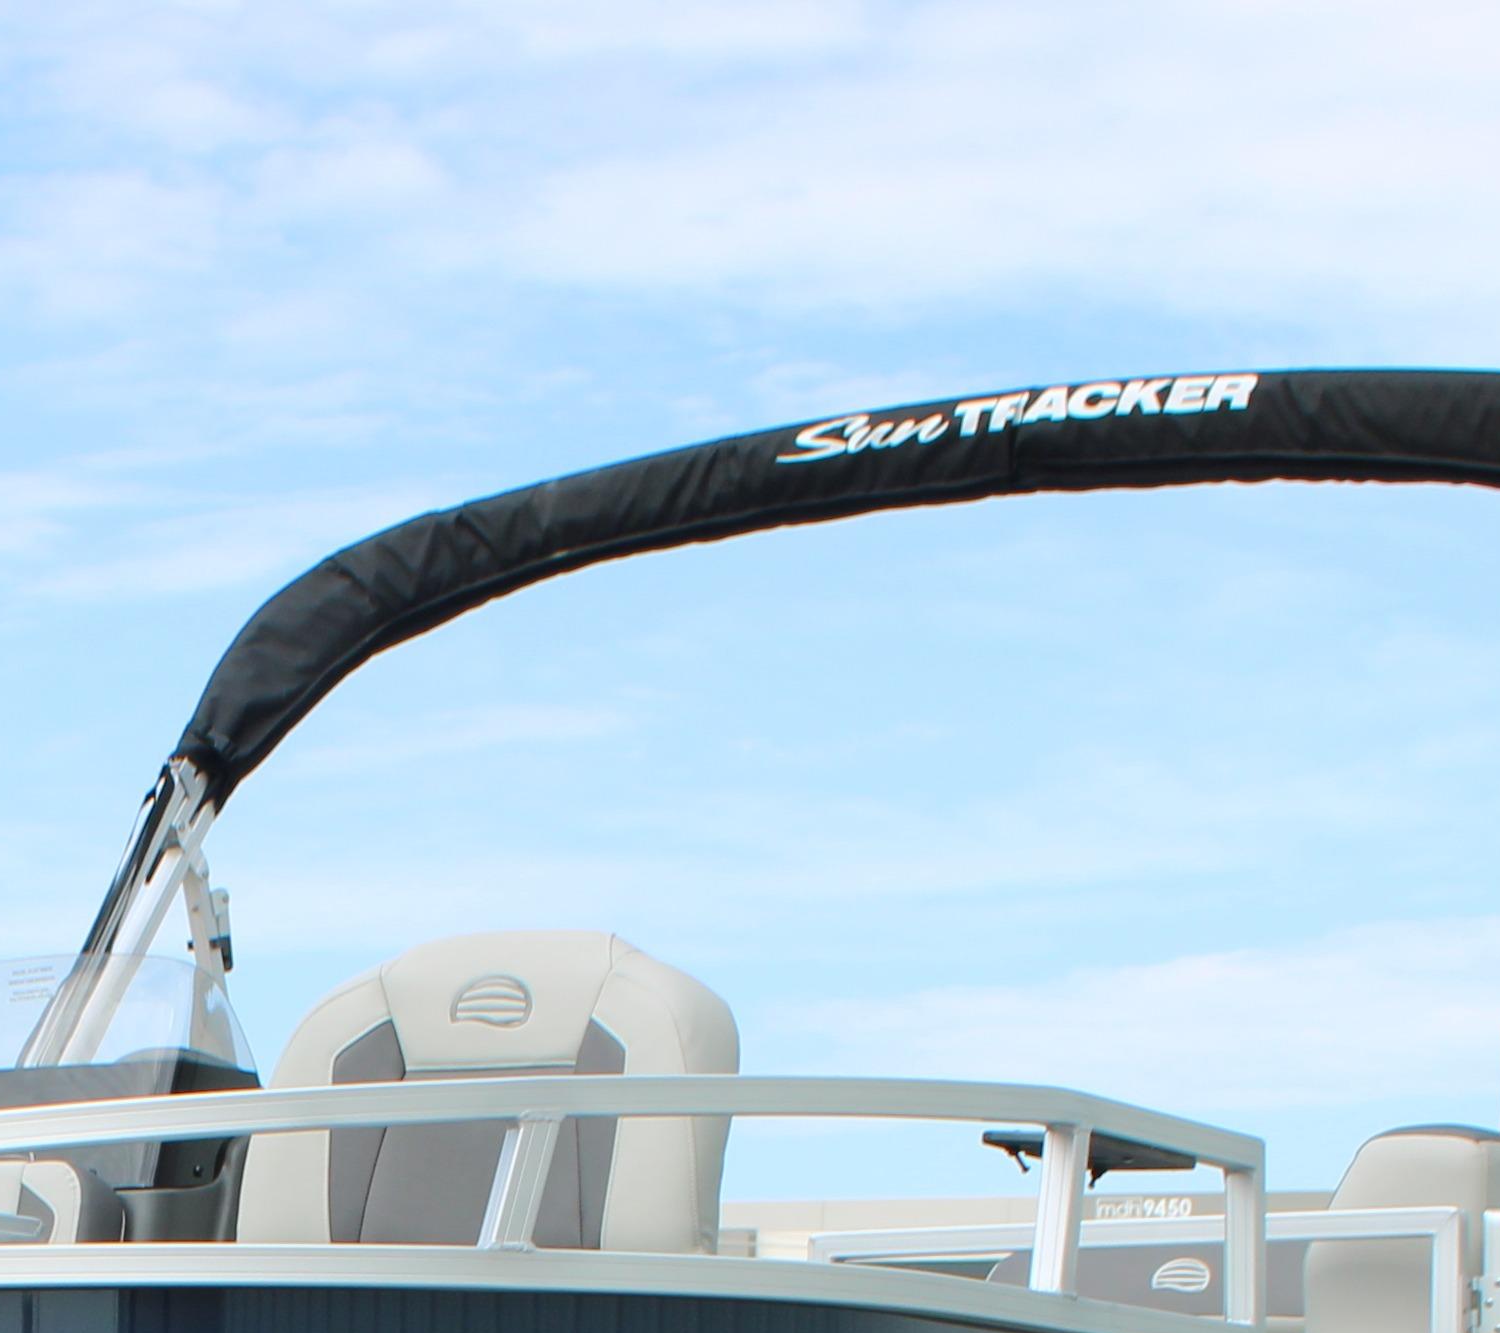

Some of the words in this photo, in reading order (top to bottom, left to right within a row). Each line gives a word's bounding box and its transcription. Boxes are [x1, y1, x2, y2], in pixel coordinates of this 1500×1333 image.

[775, 413, 951, 464] Sun
[953, 373, 1260, 438] TRACKER
[1143, 1197, 1193, 1217] 9450
